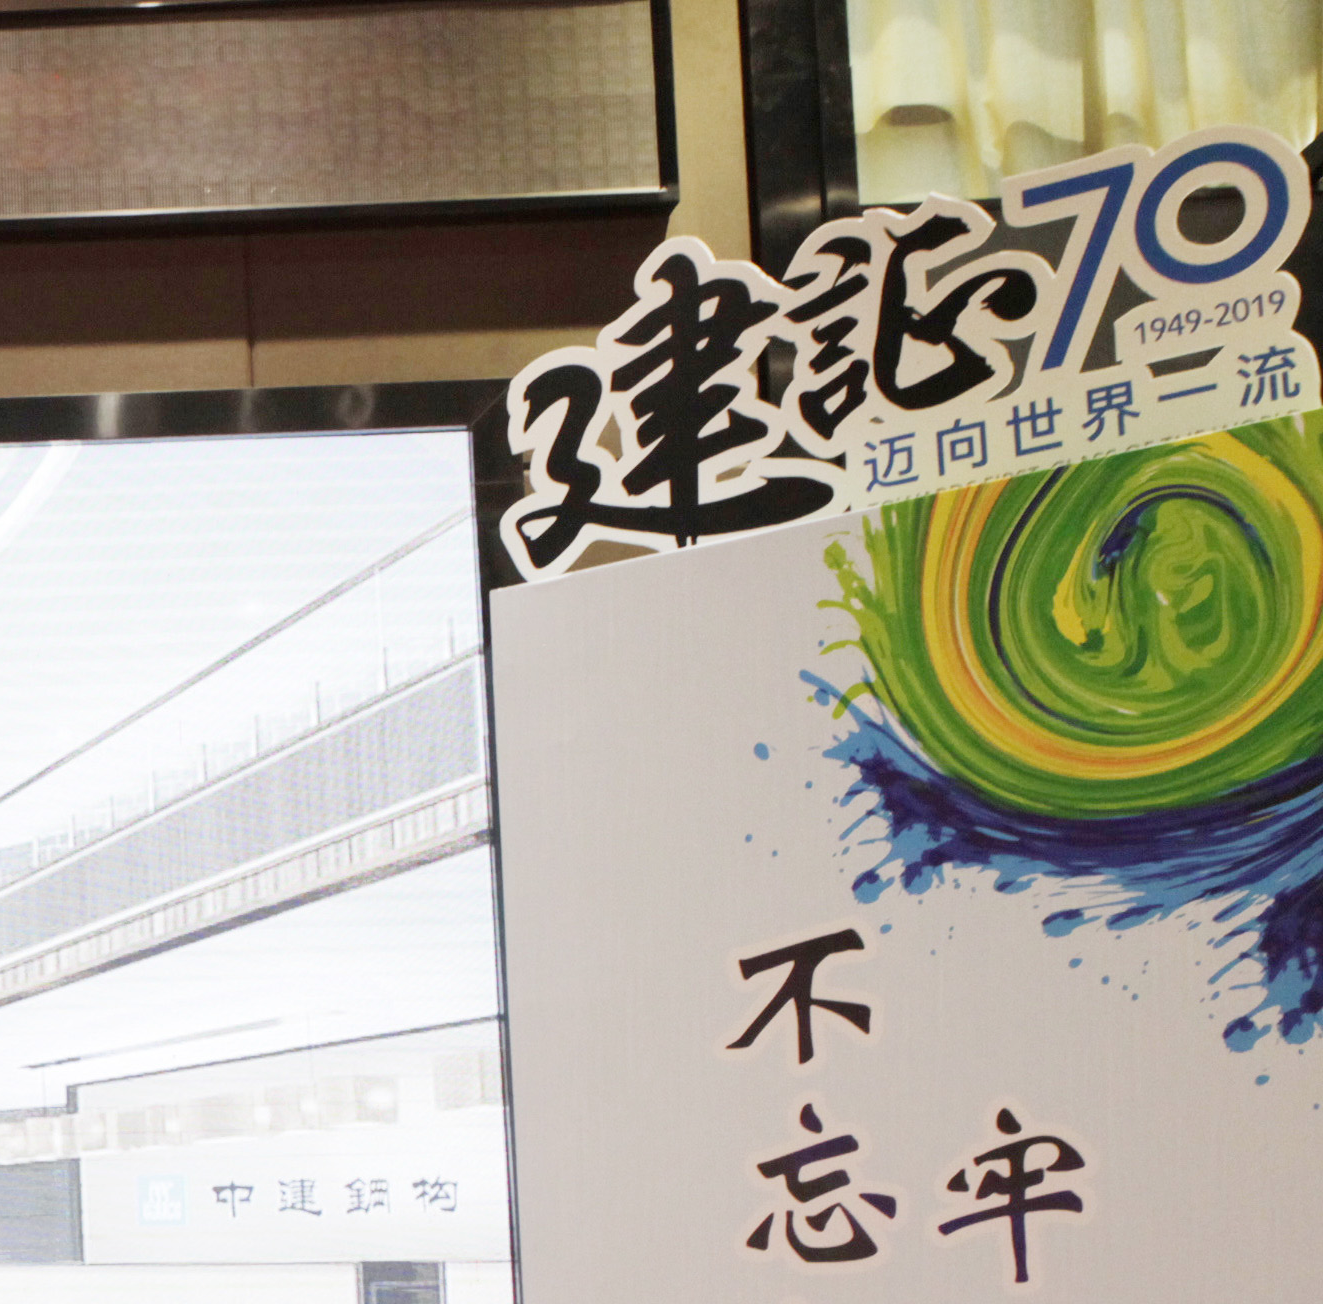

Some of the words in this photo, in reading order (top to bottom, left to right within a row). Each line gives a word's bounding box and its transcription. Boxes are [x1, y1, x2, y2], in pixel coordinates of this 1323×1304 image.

[1021, 141, 1290, 371] 70
[1133, 288, 1287, 346] 1949-2019
[863, 344, 1302, 494] 迈向世界一流
